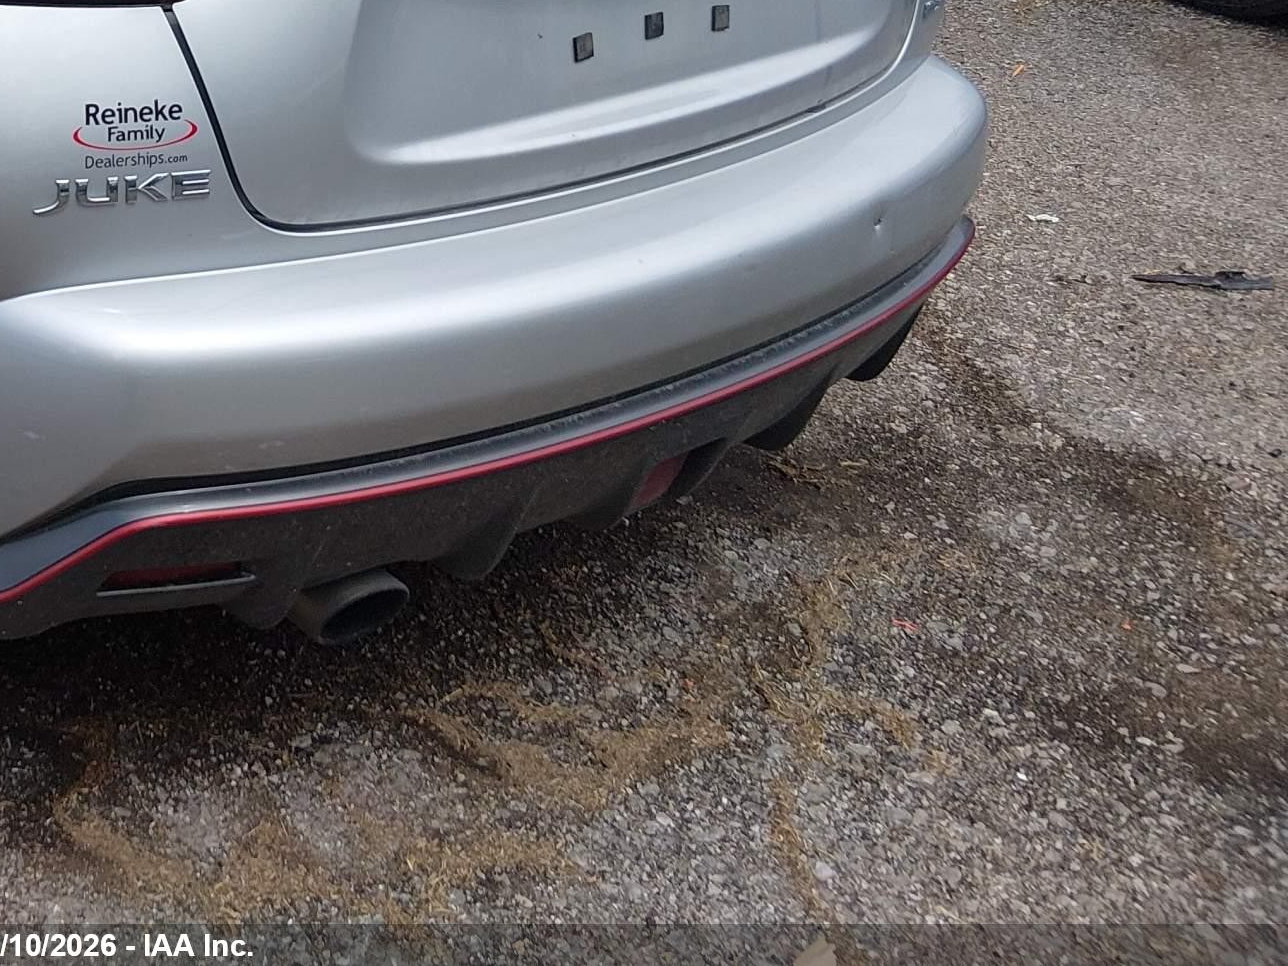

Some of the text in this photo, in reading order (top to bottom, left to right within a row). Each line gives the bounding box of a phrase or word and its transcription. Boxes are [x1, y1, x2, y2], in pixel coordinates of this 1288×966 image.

[85, 99, 184, 126] Reineke
[107, 125, 166, 143] Family
[85, 152, 188, 169] Dealerships.com
[32, 169, 212, 217] JUKE
